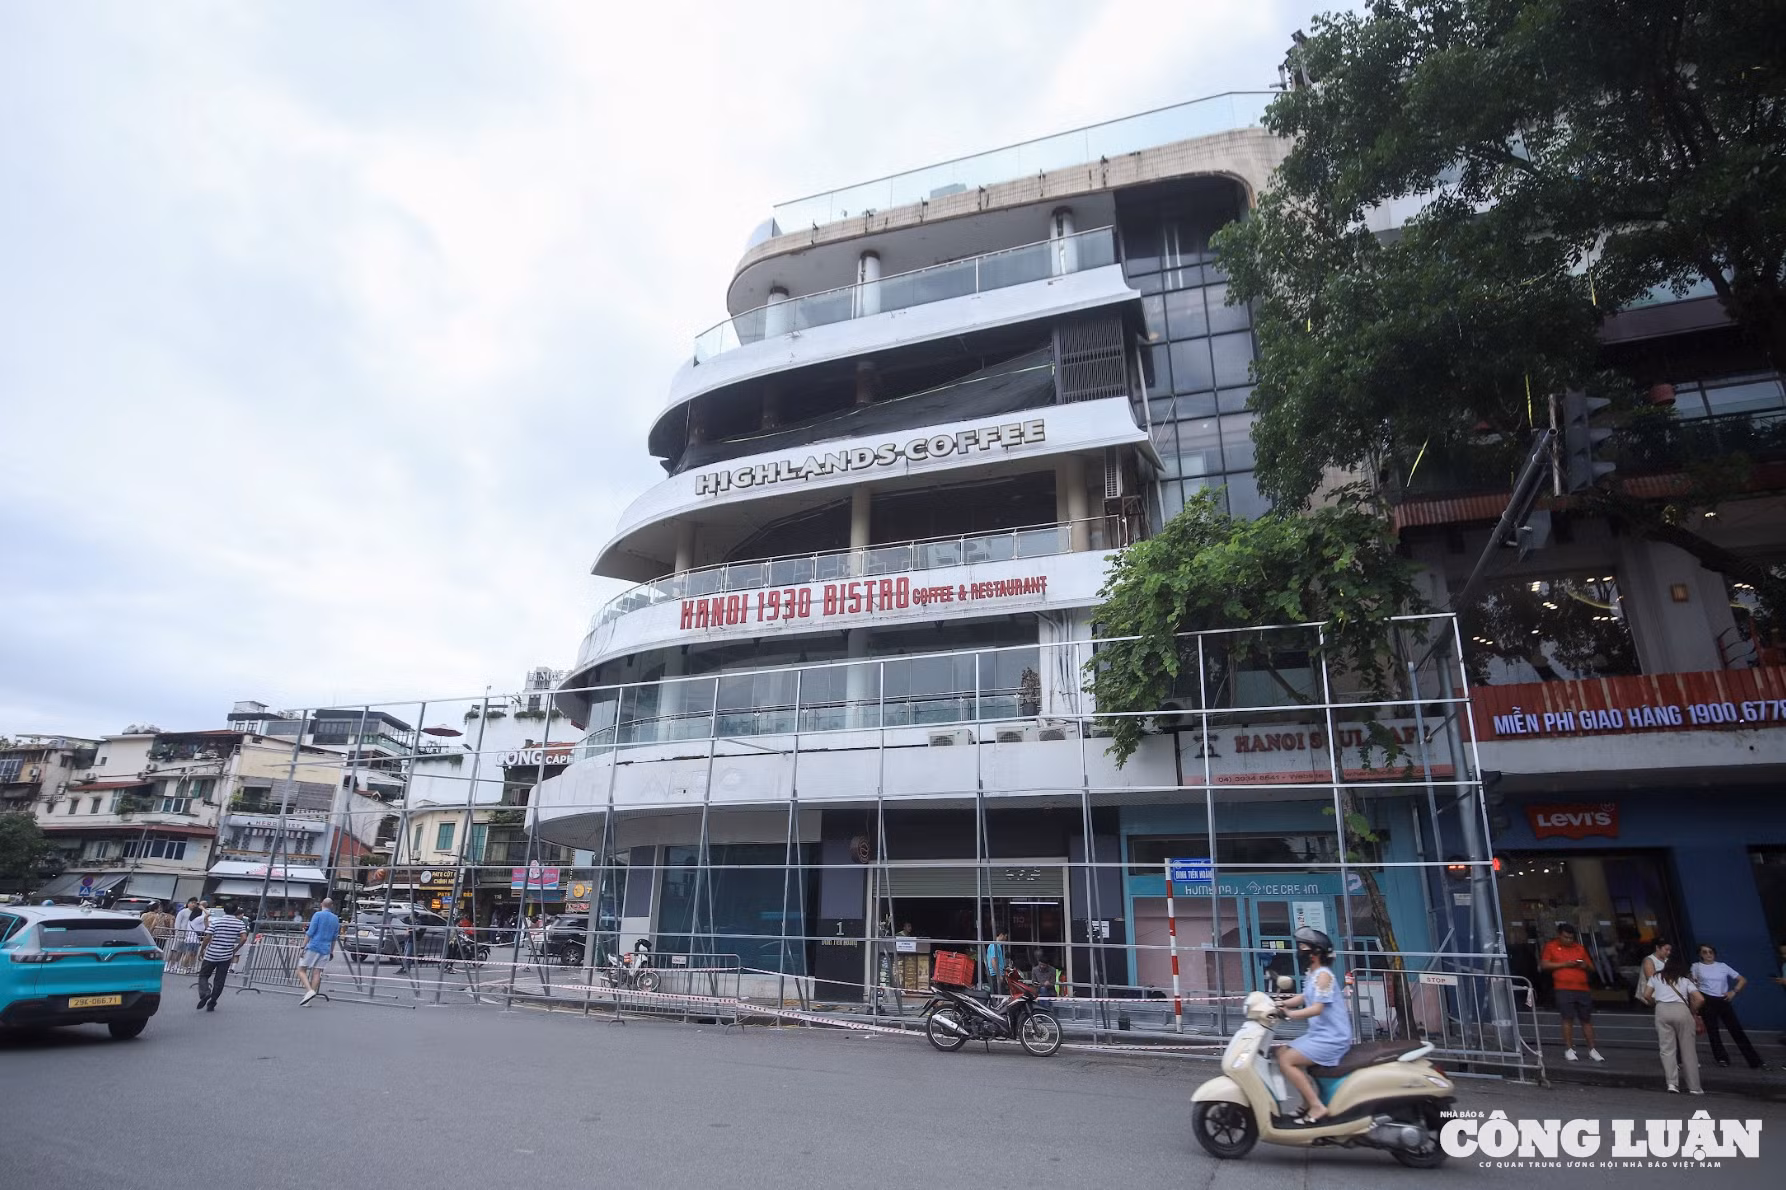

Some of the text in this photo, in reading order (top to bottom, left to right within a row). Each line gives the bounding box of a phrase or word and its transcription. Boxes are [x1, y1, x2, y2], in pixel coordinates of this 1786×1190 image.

[695, 418, 1045, 495] HIGHLANDS COFFEE
[680, 576, 1047, 630] HANOI 1930 BISTRO COFFEE & RESTAURANT
[1493, 706, 1539, 735] MIỄN
[1579, 709, 1624, 730] GIAO
[1686, 702, 1737, 725] 1900
[1234, 733, 1306, 754] HANOI
[1309, 729, 1364, 751] SUL
[1199, 867, 1213, 880] HOÀN
[836, 921, 845, 936] 1
